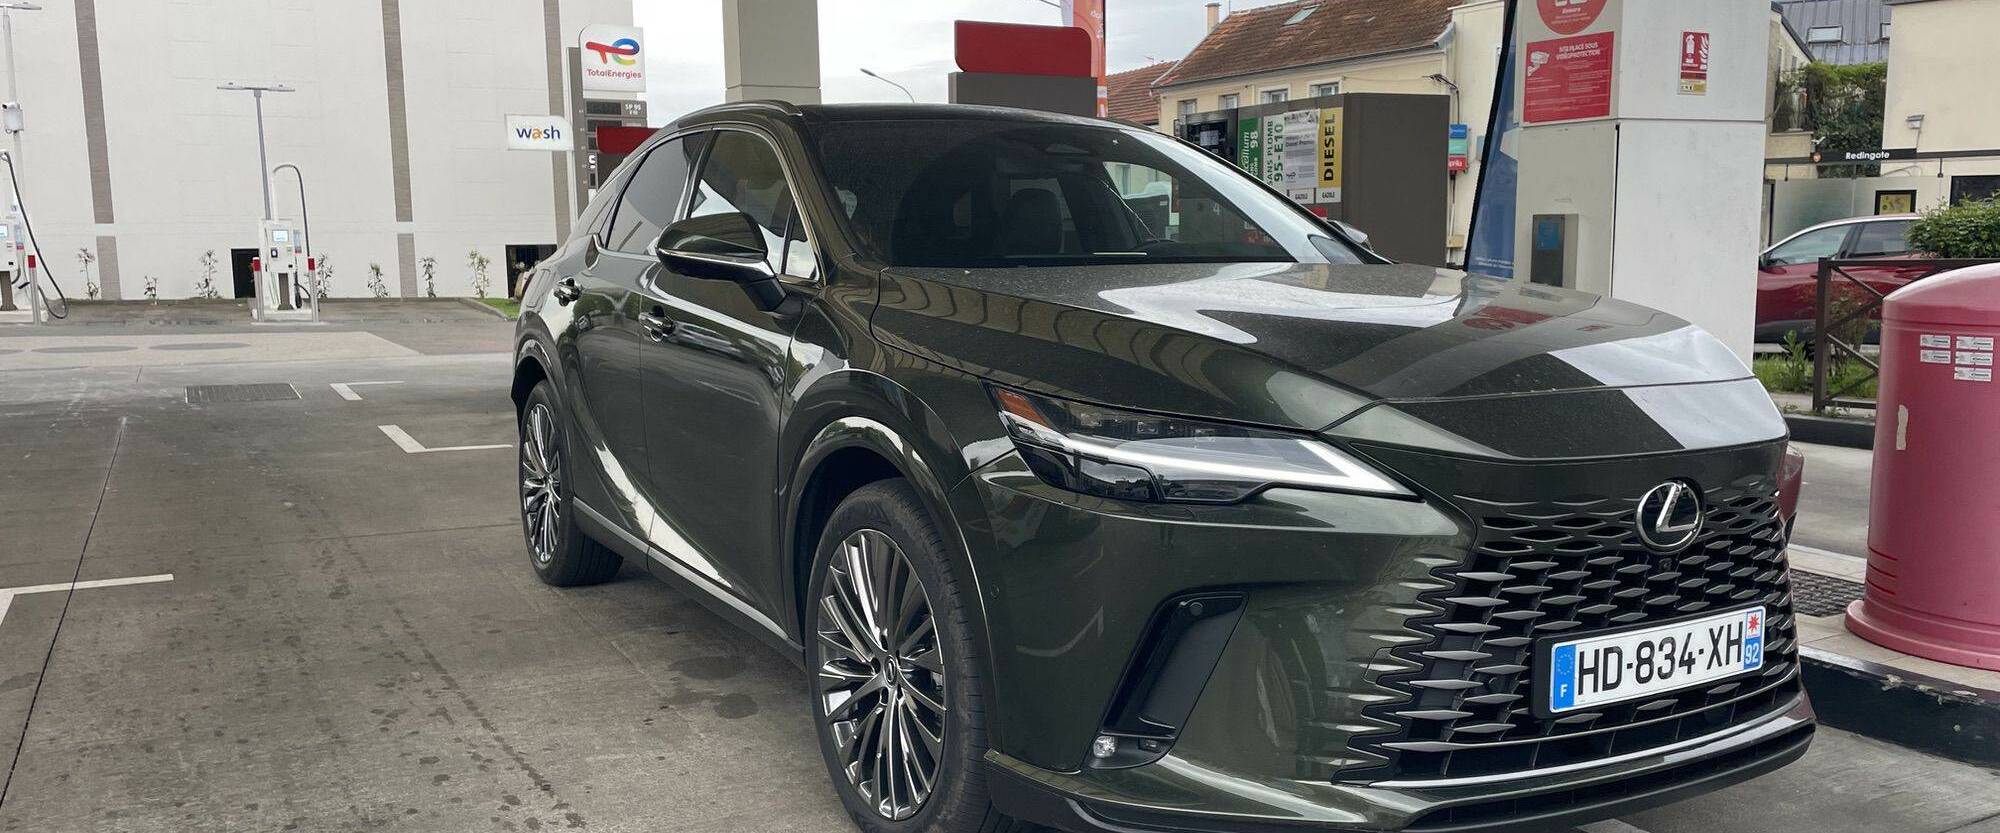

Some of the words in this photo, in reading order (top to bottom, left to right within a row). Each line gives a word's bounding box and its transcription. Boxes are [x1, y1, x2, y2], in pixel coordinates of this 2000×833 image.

[587, 68, 641, 79] TotalEnergies
[516, 125, 560, 139] wash
[1250, 131, 1258, 148] 98
[1274, 124, 1283, 182] 95-E10
[1324, 113, 1335, 181] DIESEL
[1845, 151, 1890, 160] Redingote
[1213, 203, 1220, 215] 4
[1560, 684, 1567, 698] F
[1578, 621, 1743, 696] HD-834-XH
[1744, 643, 1759, 665] 92
